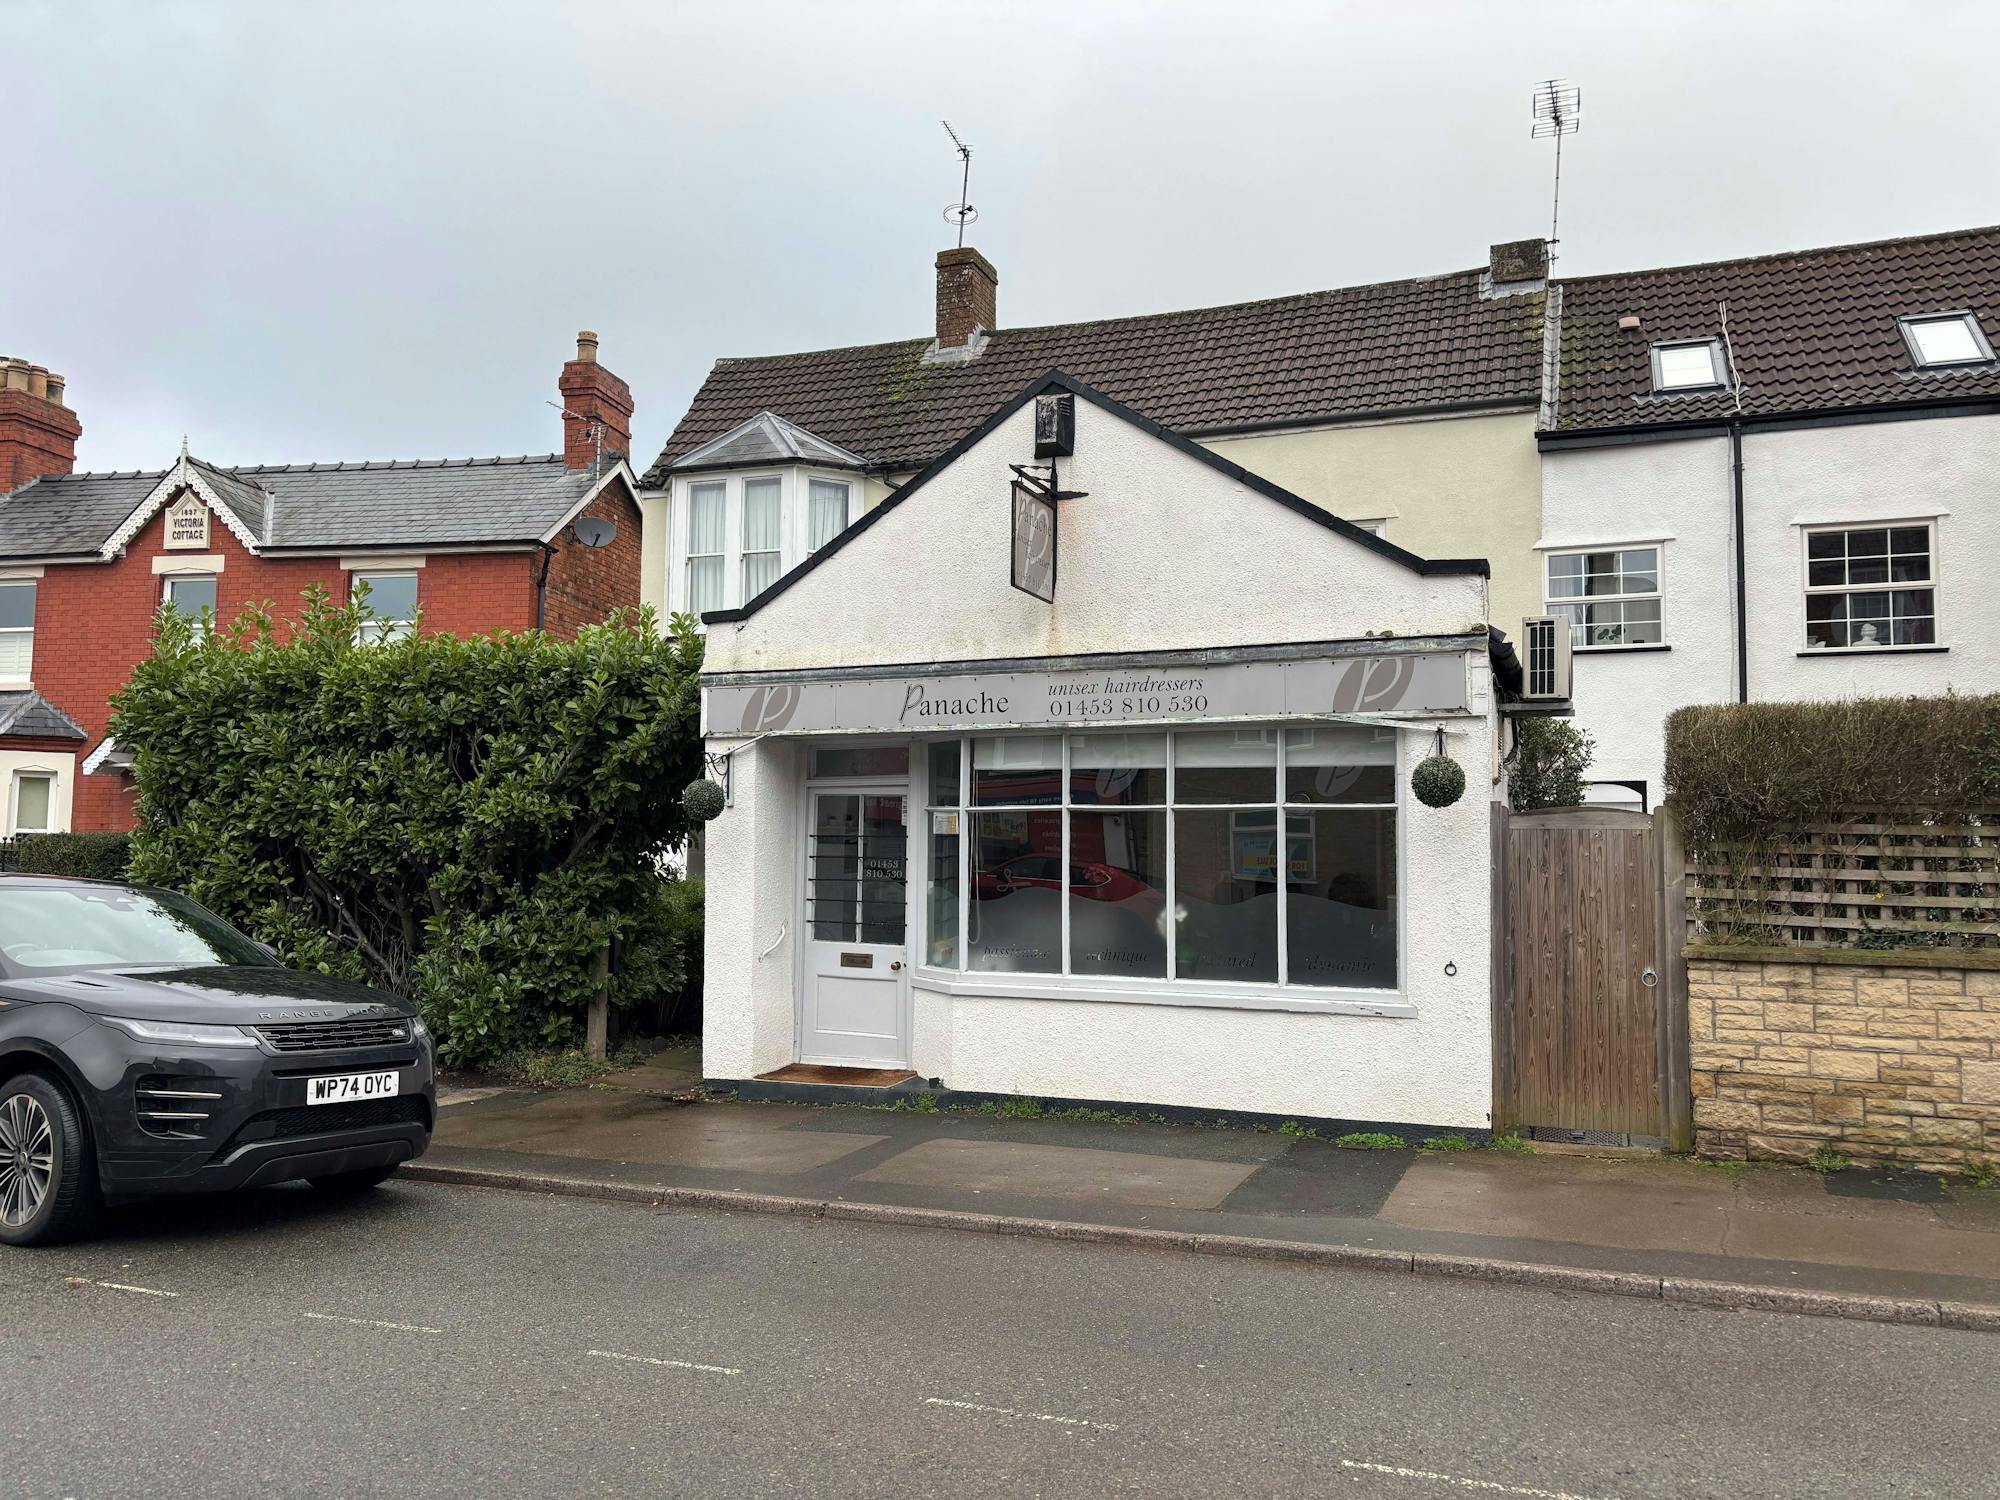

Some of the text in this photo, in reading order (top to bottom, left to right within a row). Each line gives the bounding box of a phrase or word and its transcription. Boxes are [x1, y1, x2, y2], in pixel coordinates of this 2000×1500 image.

[173, 518, 204, 528] VICTORIA
[172, 530, 204, 540] COTTAGE
[1048, 676, 1203, 696] unisex hairdressers
[899, 684, 1009, 722] Panache
[1050, 695, 1208, 716] 01453 810 530
[870, 859, 899, 869] 01453
[866, 869, 903, 878] 810 530
[258, 1006, 401, 1020] RANGE ROVER
[315, 1074, 393, 1099] WP74 OYC
